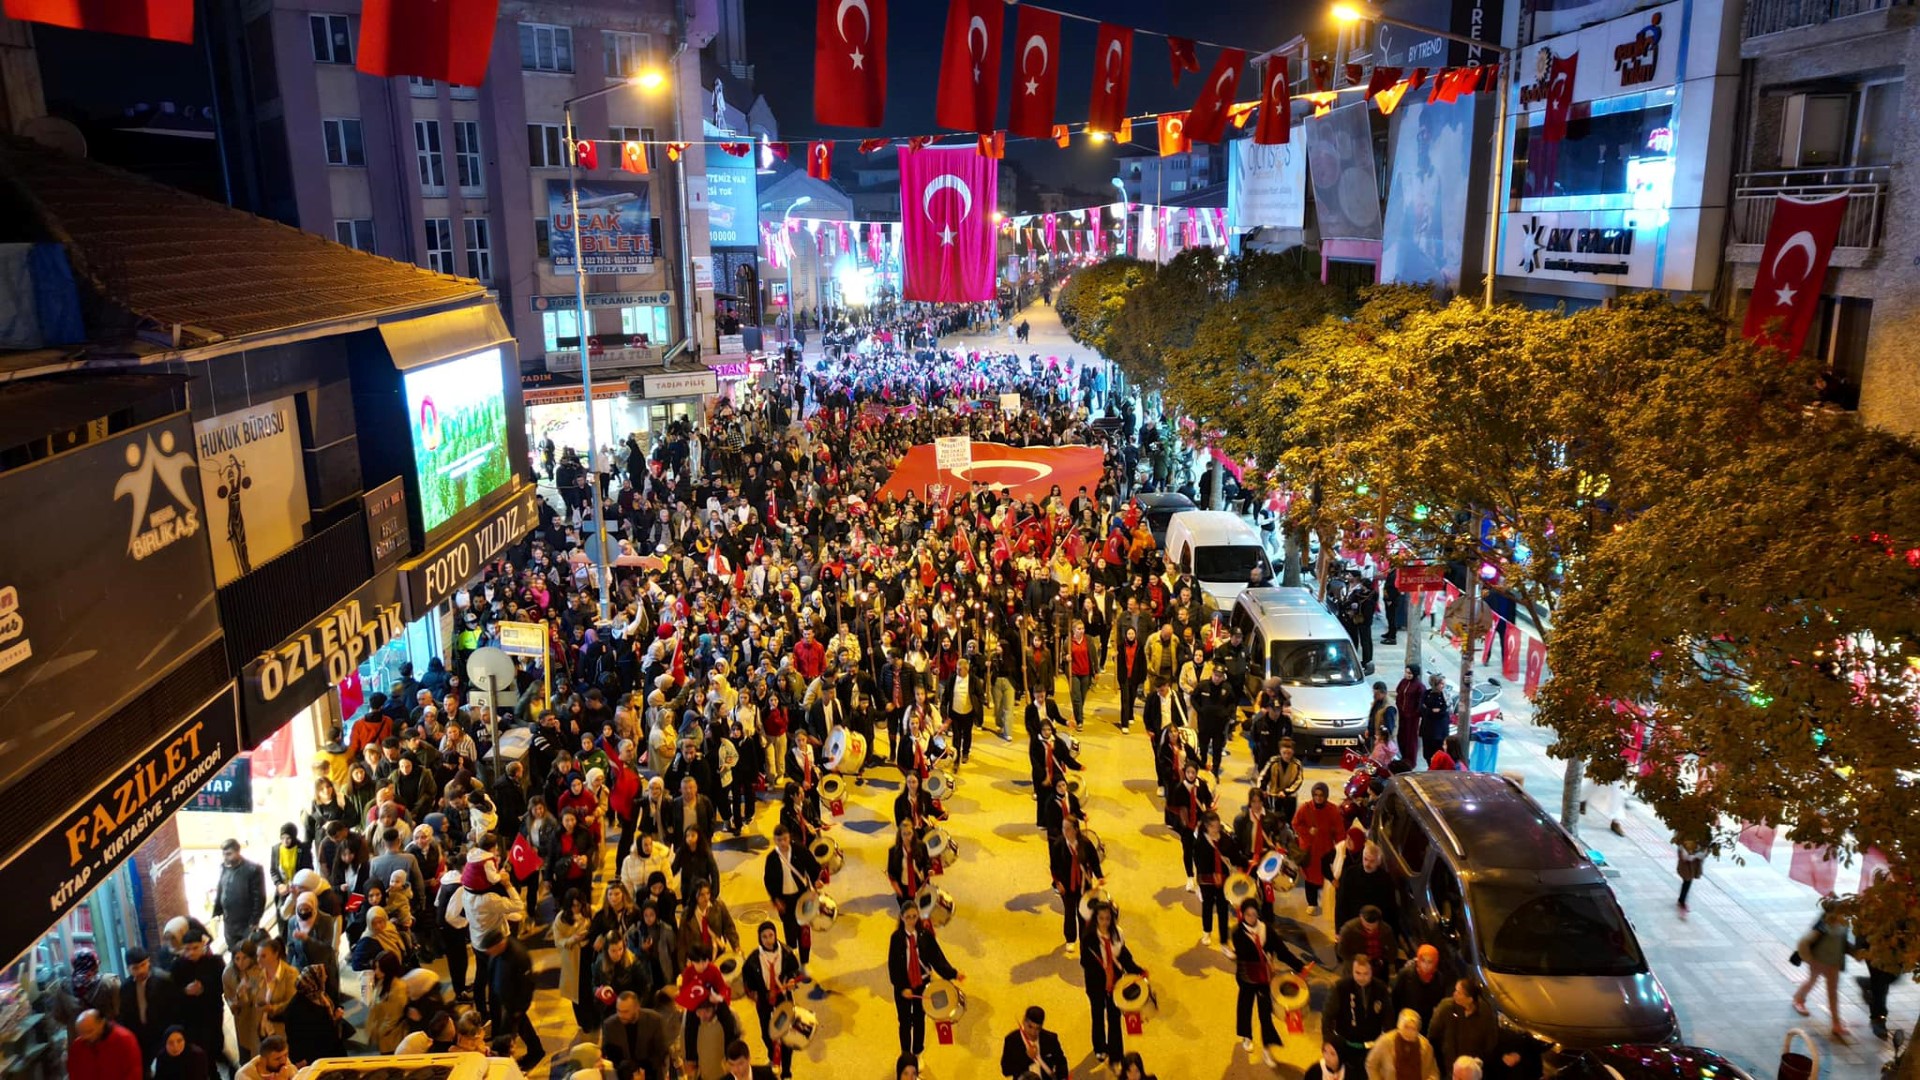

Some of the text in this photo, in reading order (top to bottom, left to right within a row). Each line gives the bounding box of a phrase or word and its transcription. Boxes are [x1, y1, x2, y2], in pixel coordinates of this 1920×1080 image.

[1408, 45, 1418, 62] BY
[1418, 37, 1442, 59] TREND
[1546, 228, 1575, 253] AK
[656, 381, 683, 390] TADIM
[200, 410, 285, 459] HUKUK BÜROSU
[425, 542, 470, 606] FOTO
[474, 505, 520, 566] YILDIZ
[259, 599, 363, 701] ÖZLEM
[327, 602, 405, 687] OPTİK
[50, 866, 92, 912] KİTAP
[103, 804, 163, 865] KIRTASİYE
[171, 741, 222, 802] FOTOKOPİ
[65, 720, 204, 868] FAZİLET
